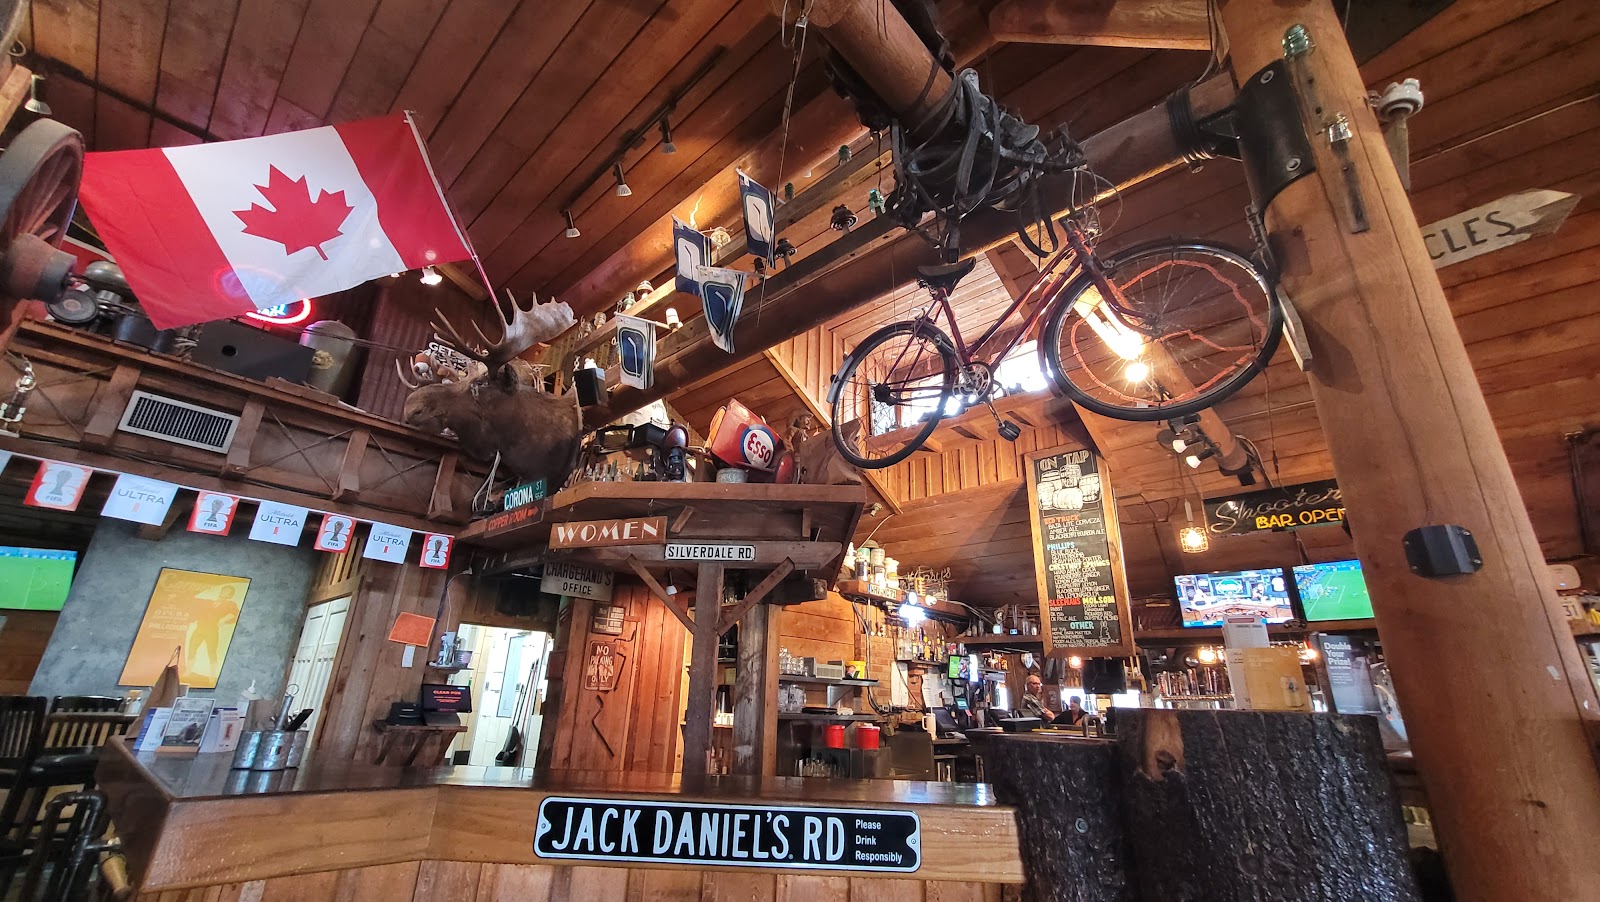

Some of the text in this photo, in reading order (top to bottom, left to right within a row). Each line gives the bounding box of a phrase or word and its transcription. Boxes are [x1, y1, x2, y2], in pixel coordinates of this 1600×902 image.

[429, 342, 455, 357] GET
[1040, 450, 1089, 471] ON TAP
[536, 480, 543, 490] ST
[44, 495, 63, 503] FIFA
[117, 488, 165, 505] ULTRA
[504, 485, 534, 510] CORONA
[260, 513, 299, 527] ULTRA
[488, 508, 528, 531] COPPER ROOM
[1056, 515, 1080, 523] TRUCK
[1062, 520, 1075, 528] LITE
[1255, 514, 1297, 529] BAR
[557, 519, 660, 543] WOMEN
[372, 534, 405, 547] ULTRA
[1046, 541, 1075, 551] PHILLIPS
[668, 546, 734, 559] SILVERDALE
[1049, 563, 1081, 571] CHESTNUT
[1082, 559, 1111, 568] SPRINGS
[545, 562, 612, 586] CHARGEHAND'S
[562, 581, 592, 596] OFFICE
[1049, 596, 1116, 607] SLEEMANS MOLSON
[1070, 621, 1095, 630] OTHER
[596, 645, 609, 655] NO
[1323, 642, 1352, 650] Double
[1325, 650, 1345, 658] Your
[1327, 657, 1352, 666] Prize!
[855, 819, 882, 831] Please
[551, 807, 640, 854] JACK
[803, 816, 845, 861] RD
[855, 835, 877, 846] Drink
[855, 850, 903, 864] Responsibly
